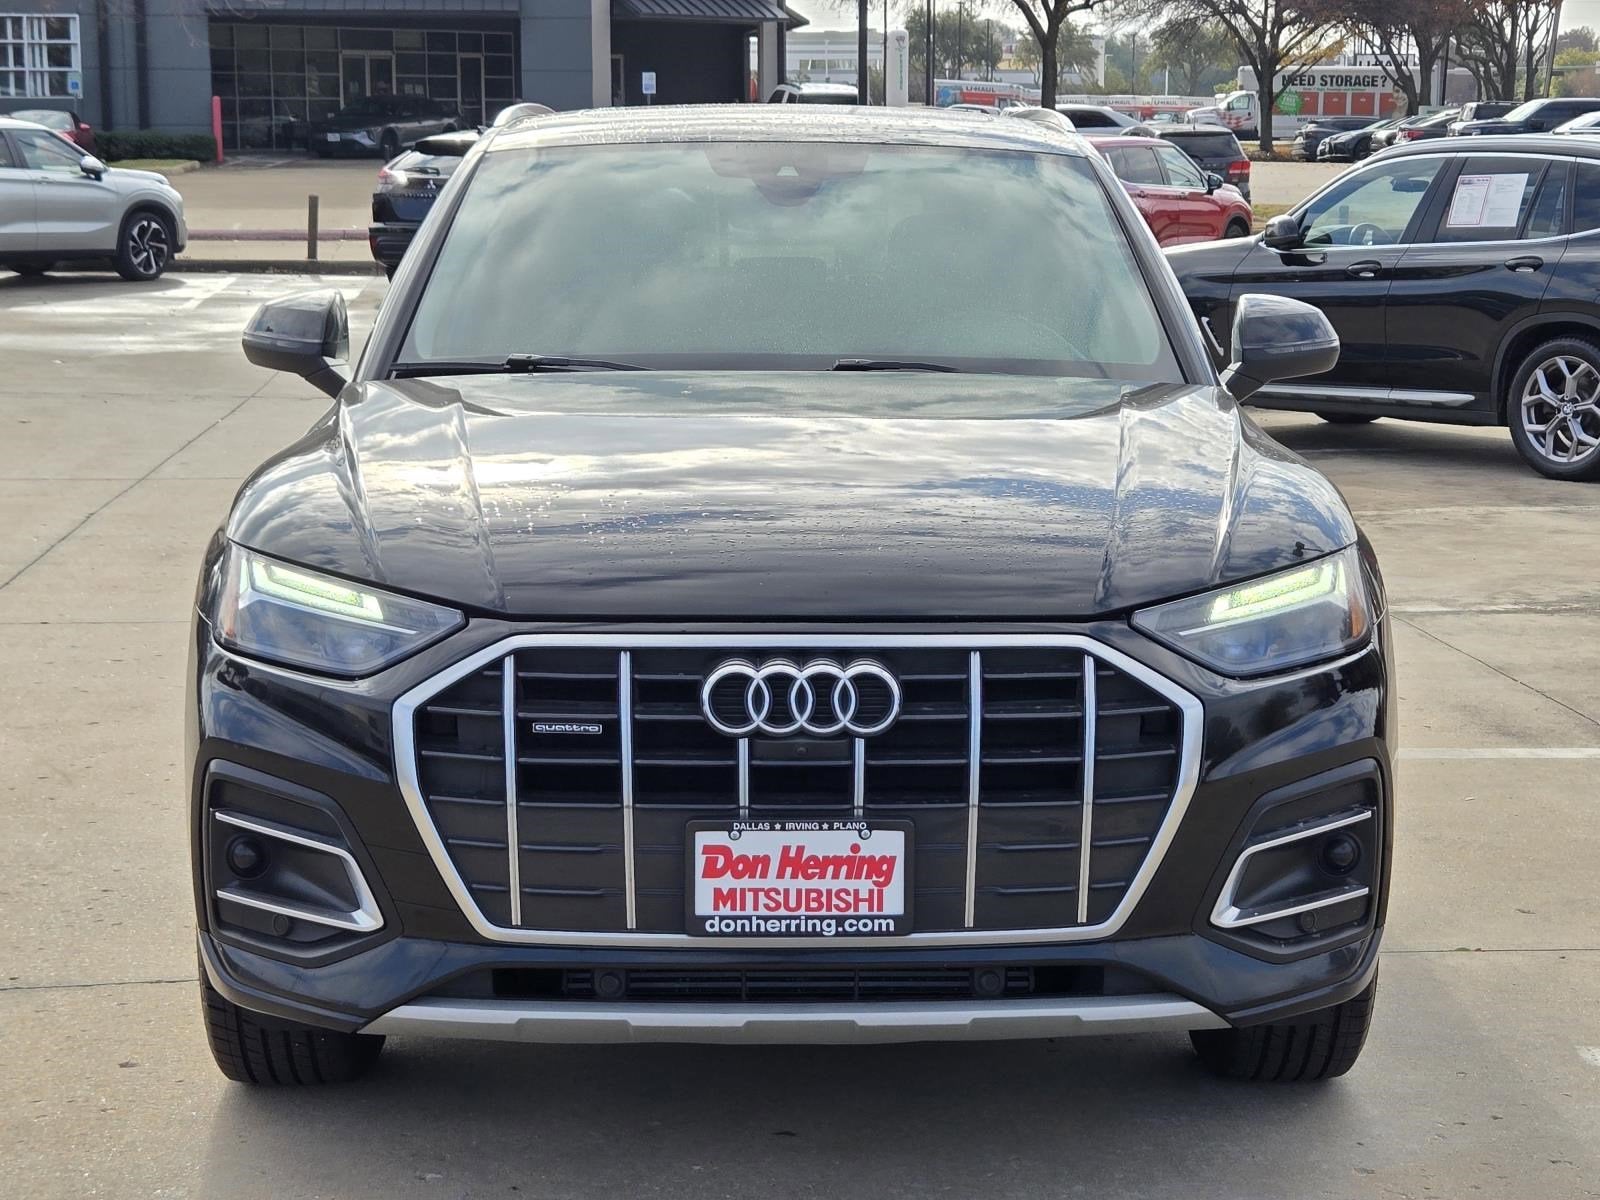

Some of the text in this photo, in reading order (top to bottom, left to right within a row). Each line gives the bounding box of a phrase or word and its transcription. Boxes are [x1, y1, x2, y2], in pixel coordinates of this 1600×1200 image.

[1282, 74, 1388, 88] NEED STORAGE?
[535, 724, 599, 733] quattro
[733, 822, 867, 831] DALLAS IRVING PLANO
[701, 843, 897, 888] Don Herring
[712, 887, 884, 913] MITSUBISHI
[704, 915, 895, 936] donherring.com
